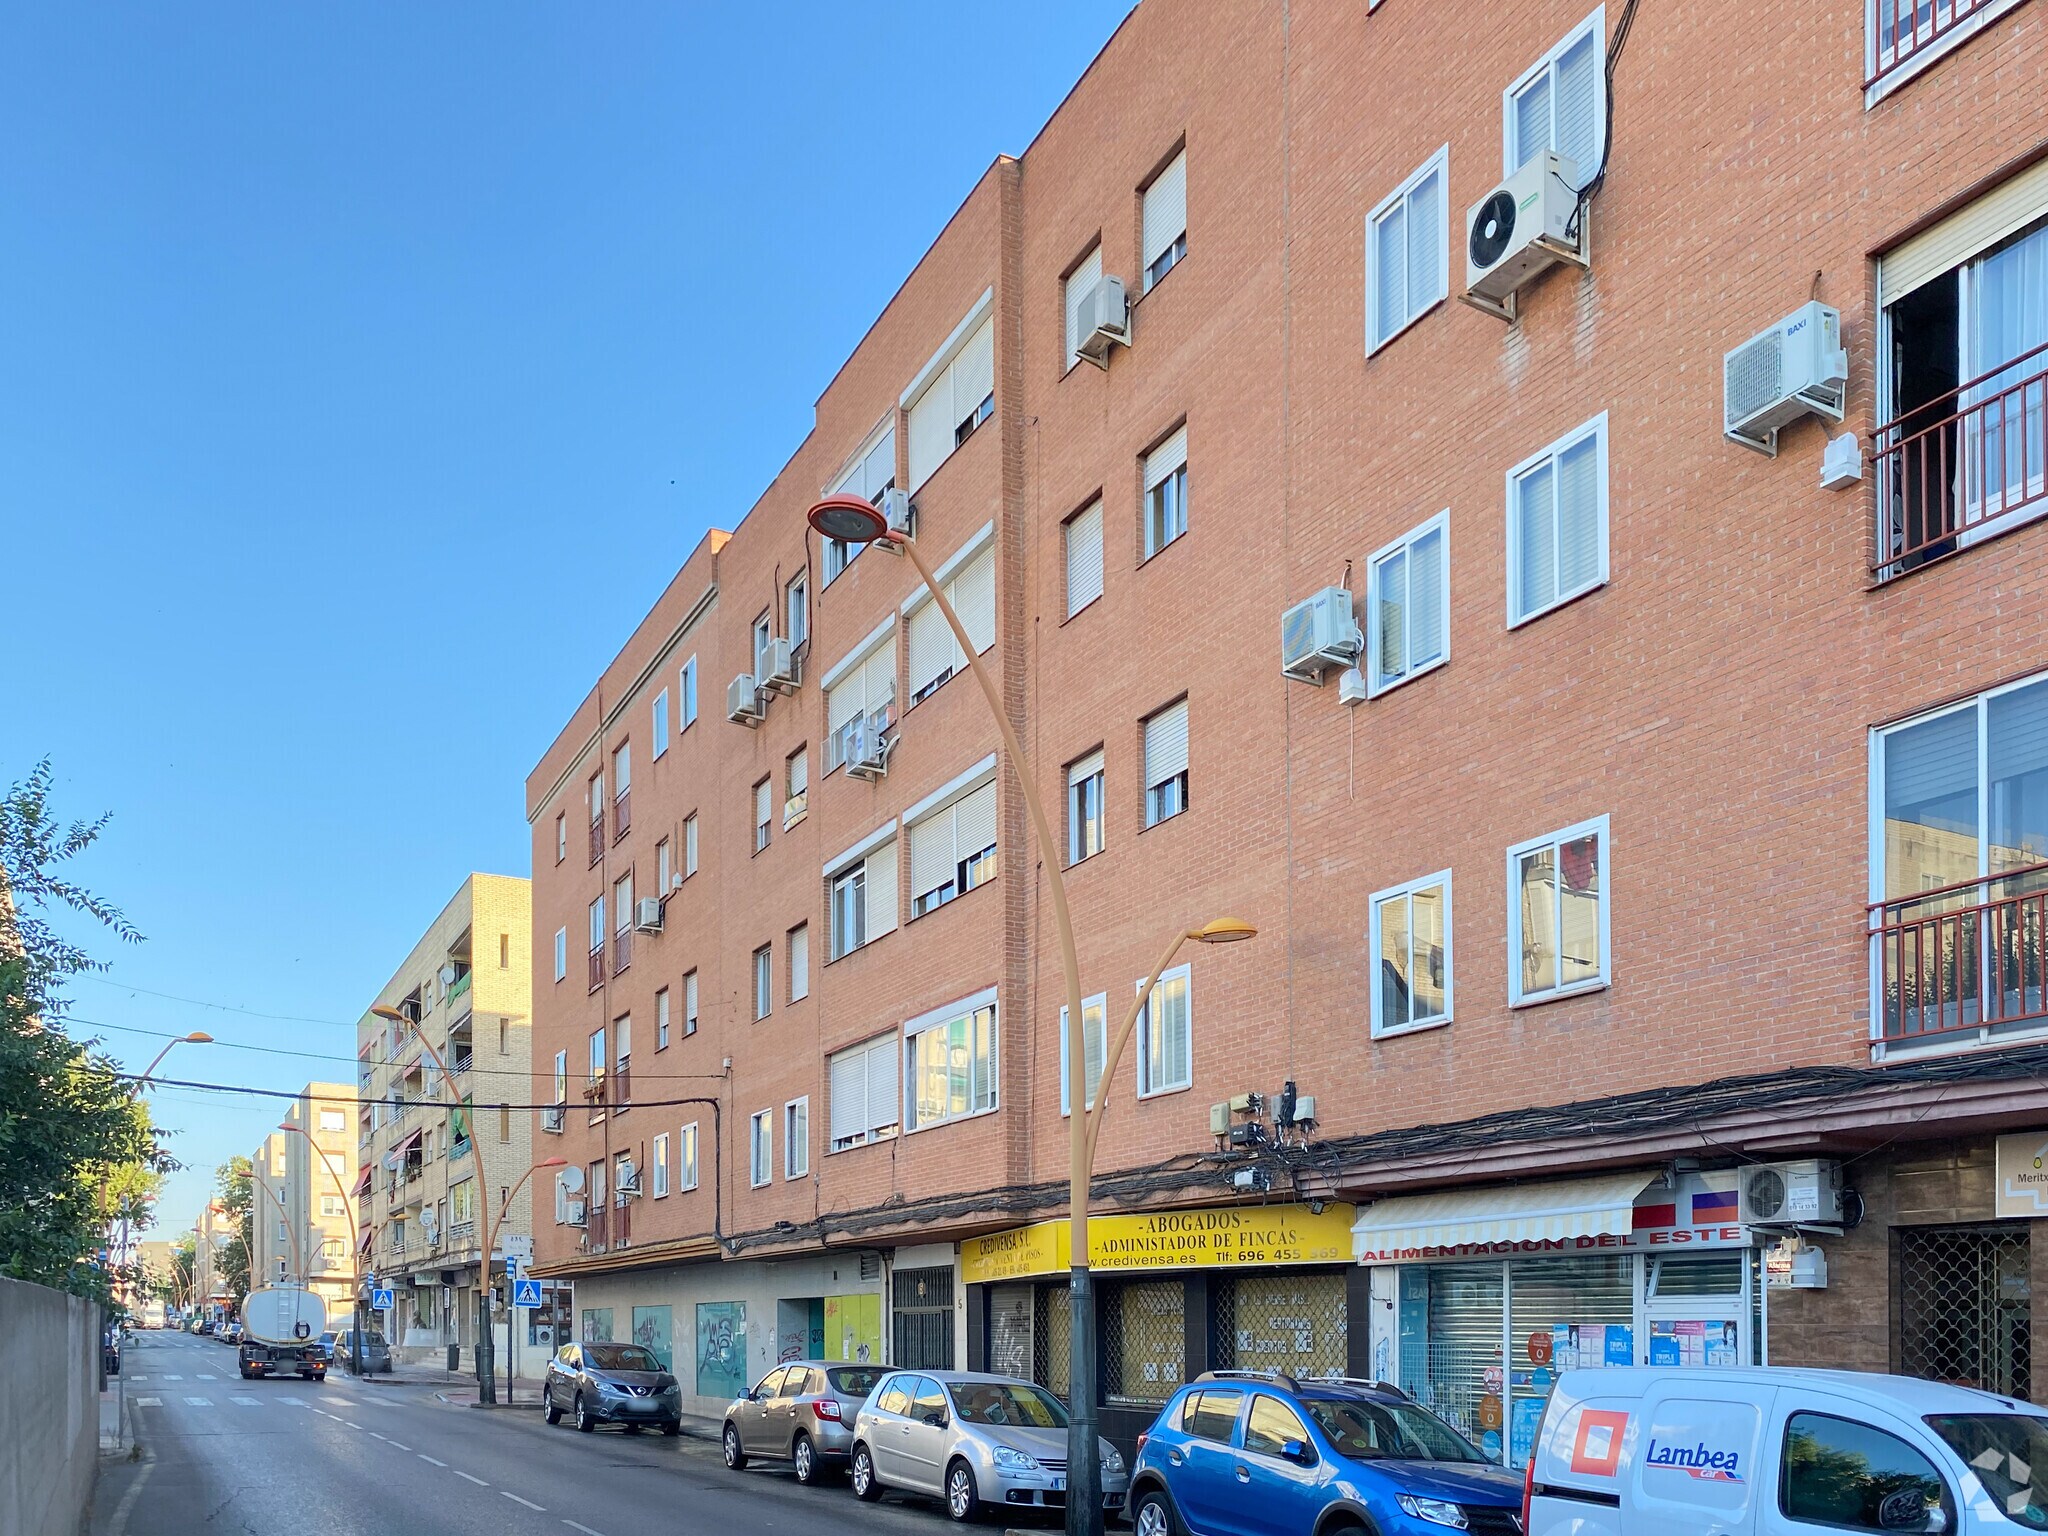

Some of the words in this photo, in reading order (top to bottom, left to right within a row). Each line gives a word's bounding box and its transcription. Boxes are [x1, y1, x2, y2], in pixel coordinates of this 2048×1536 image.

[1788, 318, 1806, 336] BAXI
[1213, 1233, 1232, 1248] DE
[1577, 1234, 1637, 1249] DEL
[1650, 1227, 1741, 1244] ESTE
[1216, 1252, 1232, 1262] Tlf:
[1238, 1250, 1264, 1261] 696
[1273, 1249, 1300, 1260] 455
[958, 1298, 963, 1310] 5
[1646, 1439, 1739, 1470] Lambea
[1700, 1470, 1718, 1478] car
